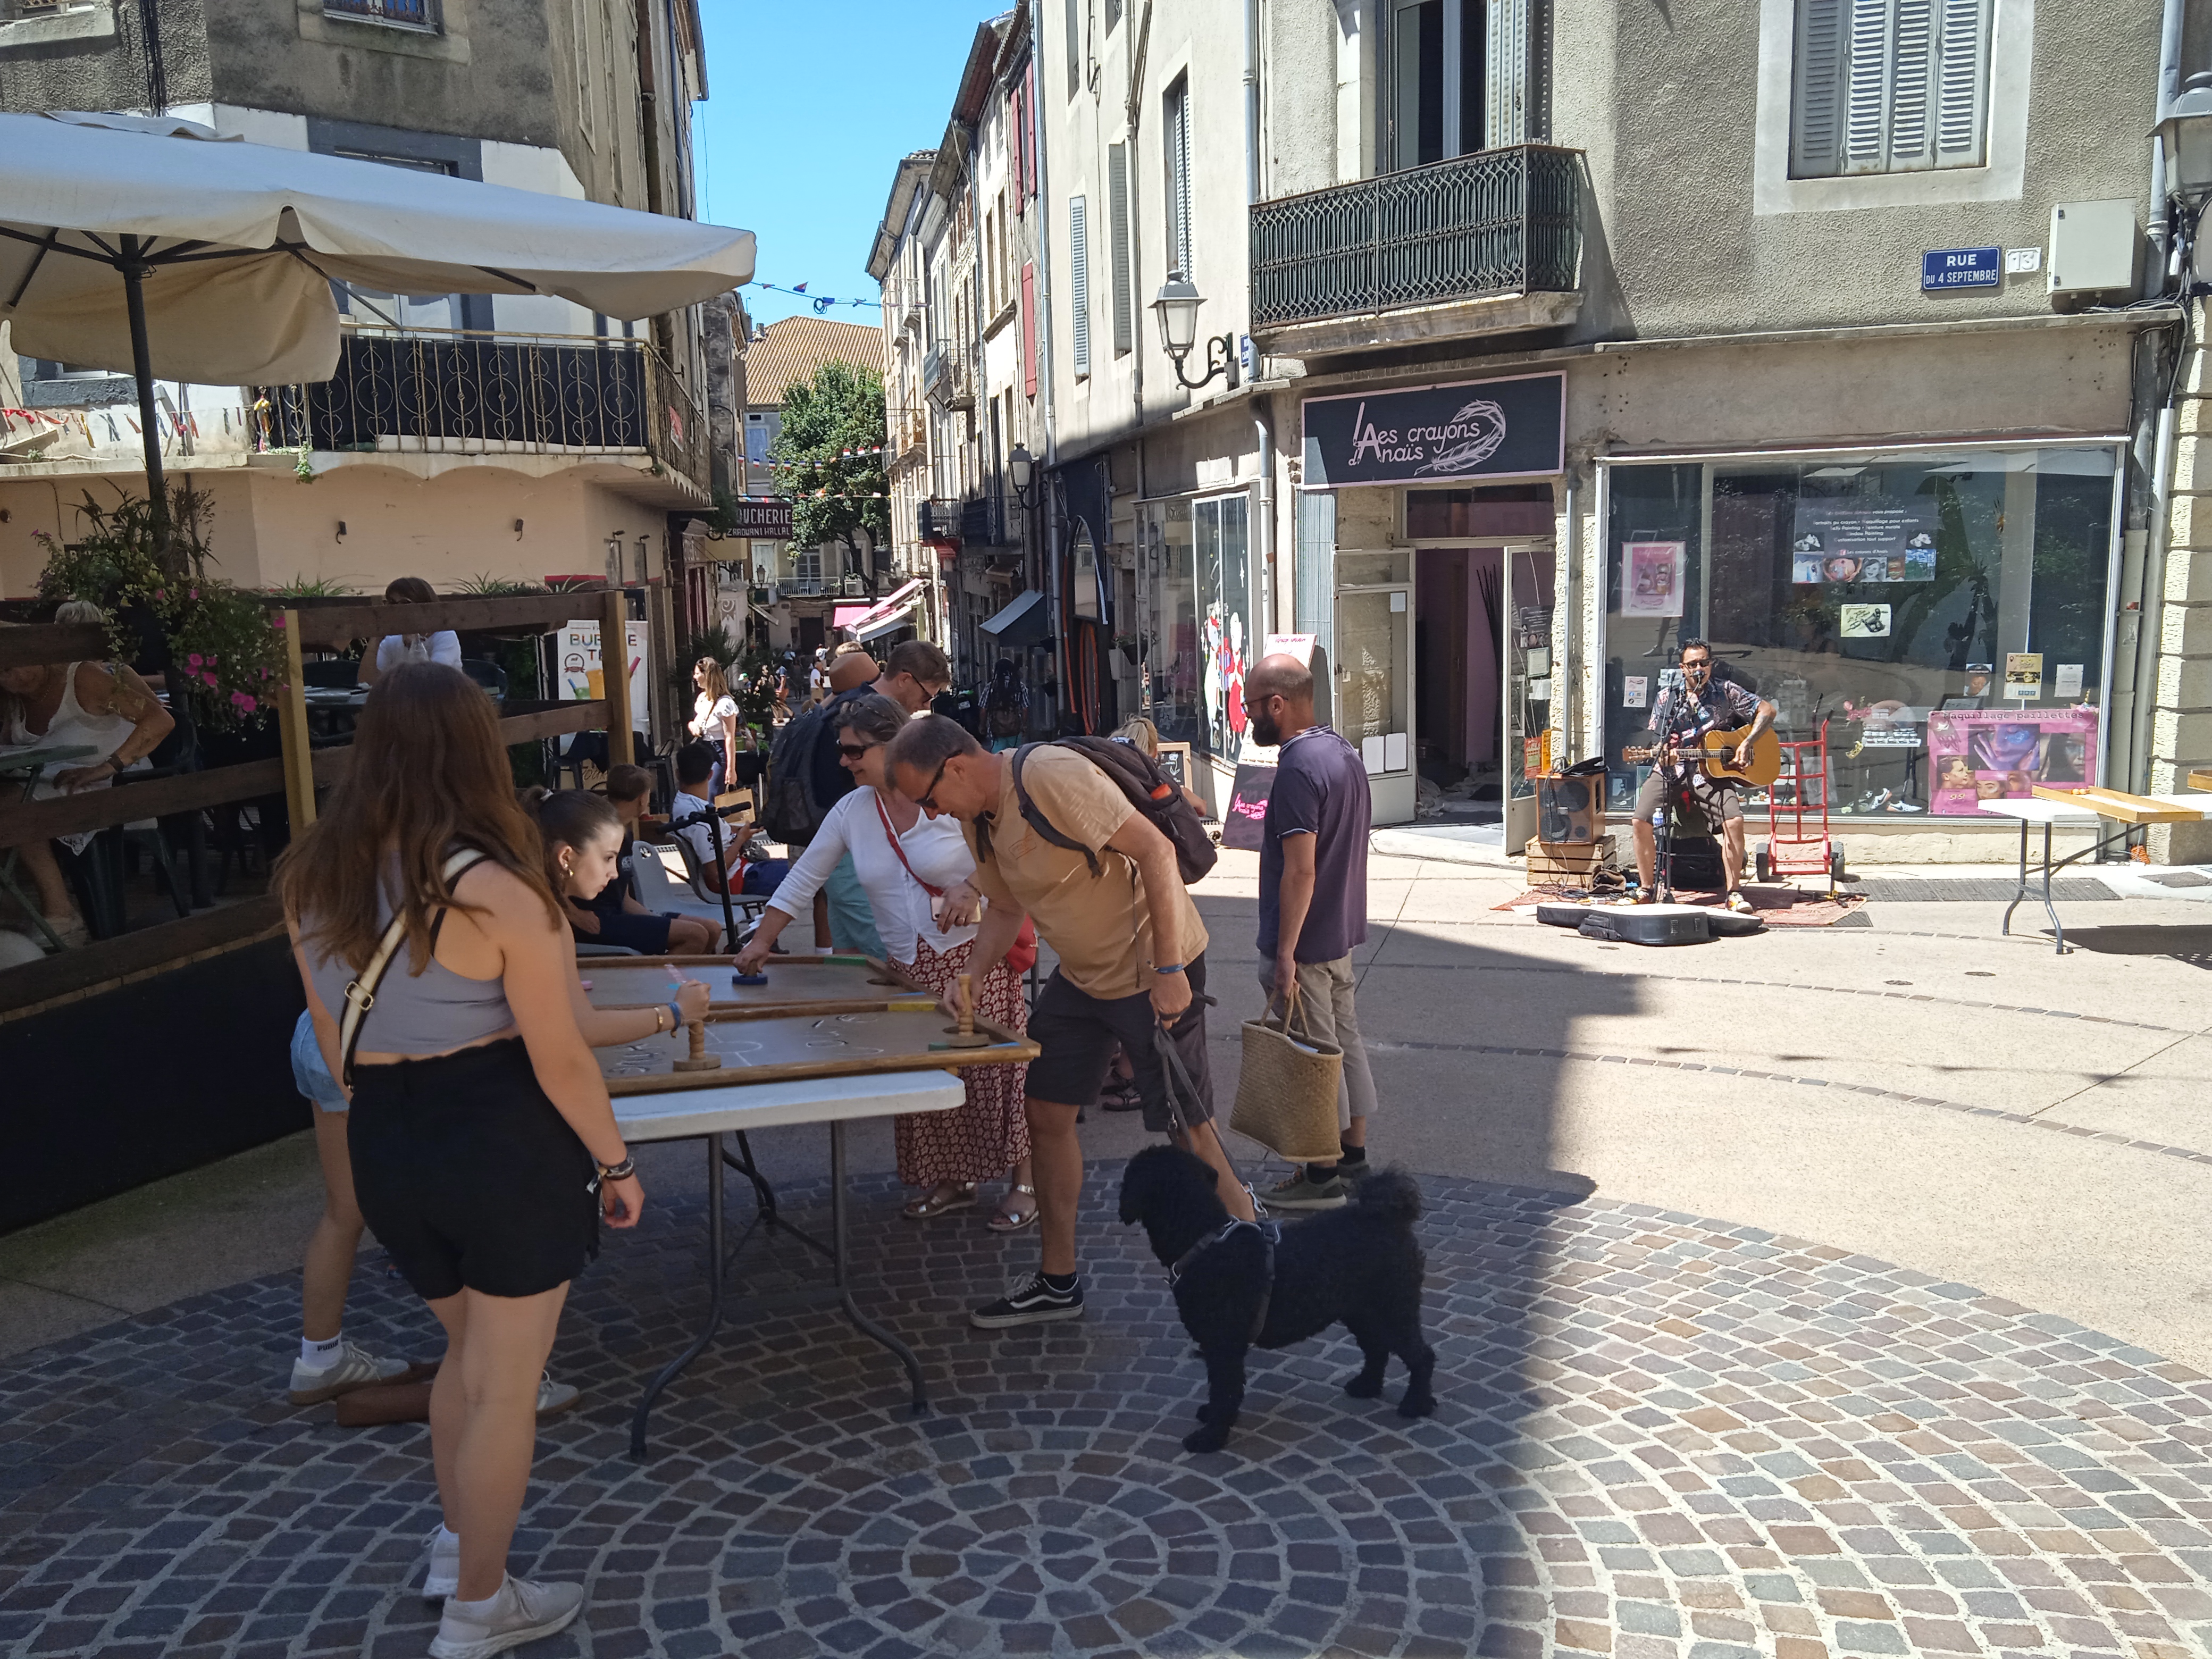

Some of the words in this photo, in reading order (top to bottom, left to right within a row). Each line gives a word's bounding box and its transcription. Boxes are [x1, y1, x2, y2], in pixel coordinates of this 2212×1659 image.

[1947, 254, 1977, 266] RUE
[2013, 252, 2034, 270] 13
[1926, 275, 1936, 284] DU
[1938, 272, 1944, 283] 4
[1947, 270, 1996, 282] SEPTEMBRE
[1407, 422, 1480, 454] crayons
[736, 508, 792, 524] OUCHERIE
[764, 527, 790, 535] HALLAL
[1943, 711, 2009, 722] Maquillage
[2016, 711, 2083, 720] paillettes
